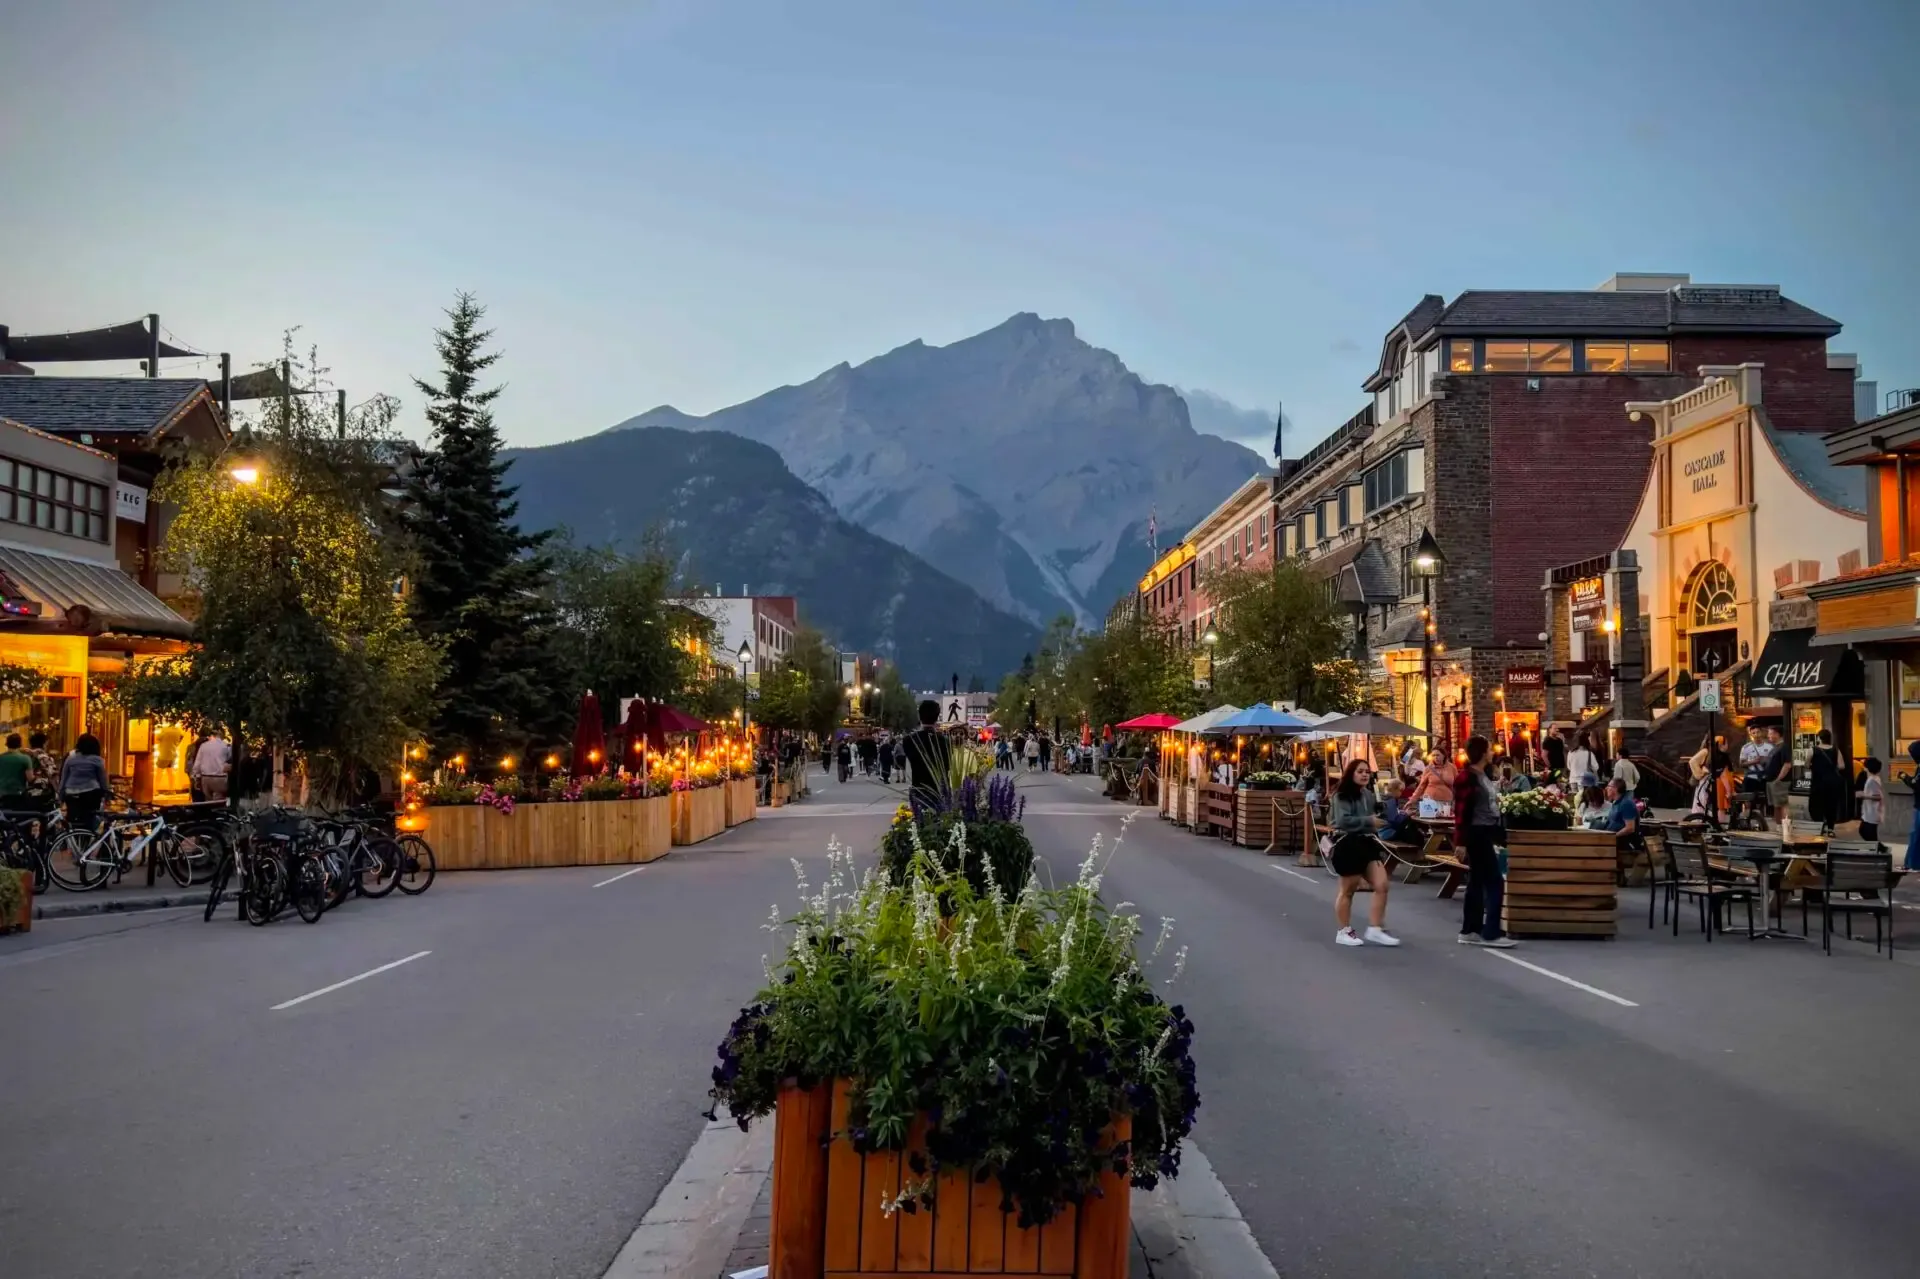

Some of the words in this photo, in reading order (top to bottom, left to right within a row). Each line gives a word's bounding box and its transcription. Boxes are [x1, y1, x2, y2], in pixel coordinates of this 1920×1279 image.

[1684, 449, 1726, 477] CASCADE
[1692, 473, 1718, 494] HALL
[123, 492, 140, 505] KEG
[1764, 659, 1824, 686] CHAYA
